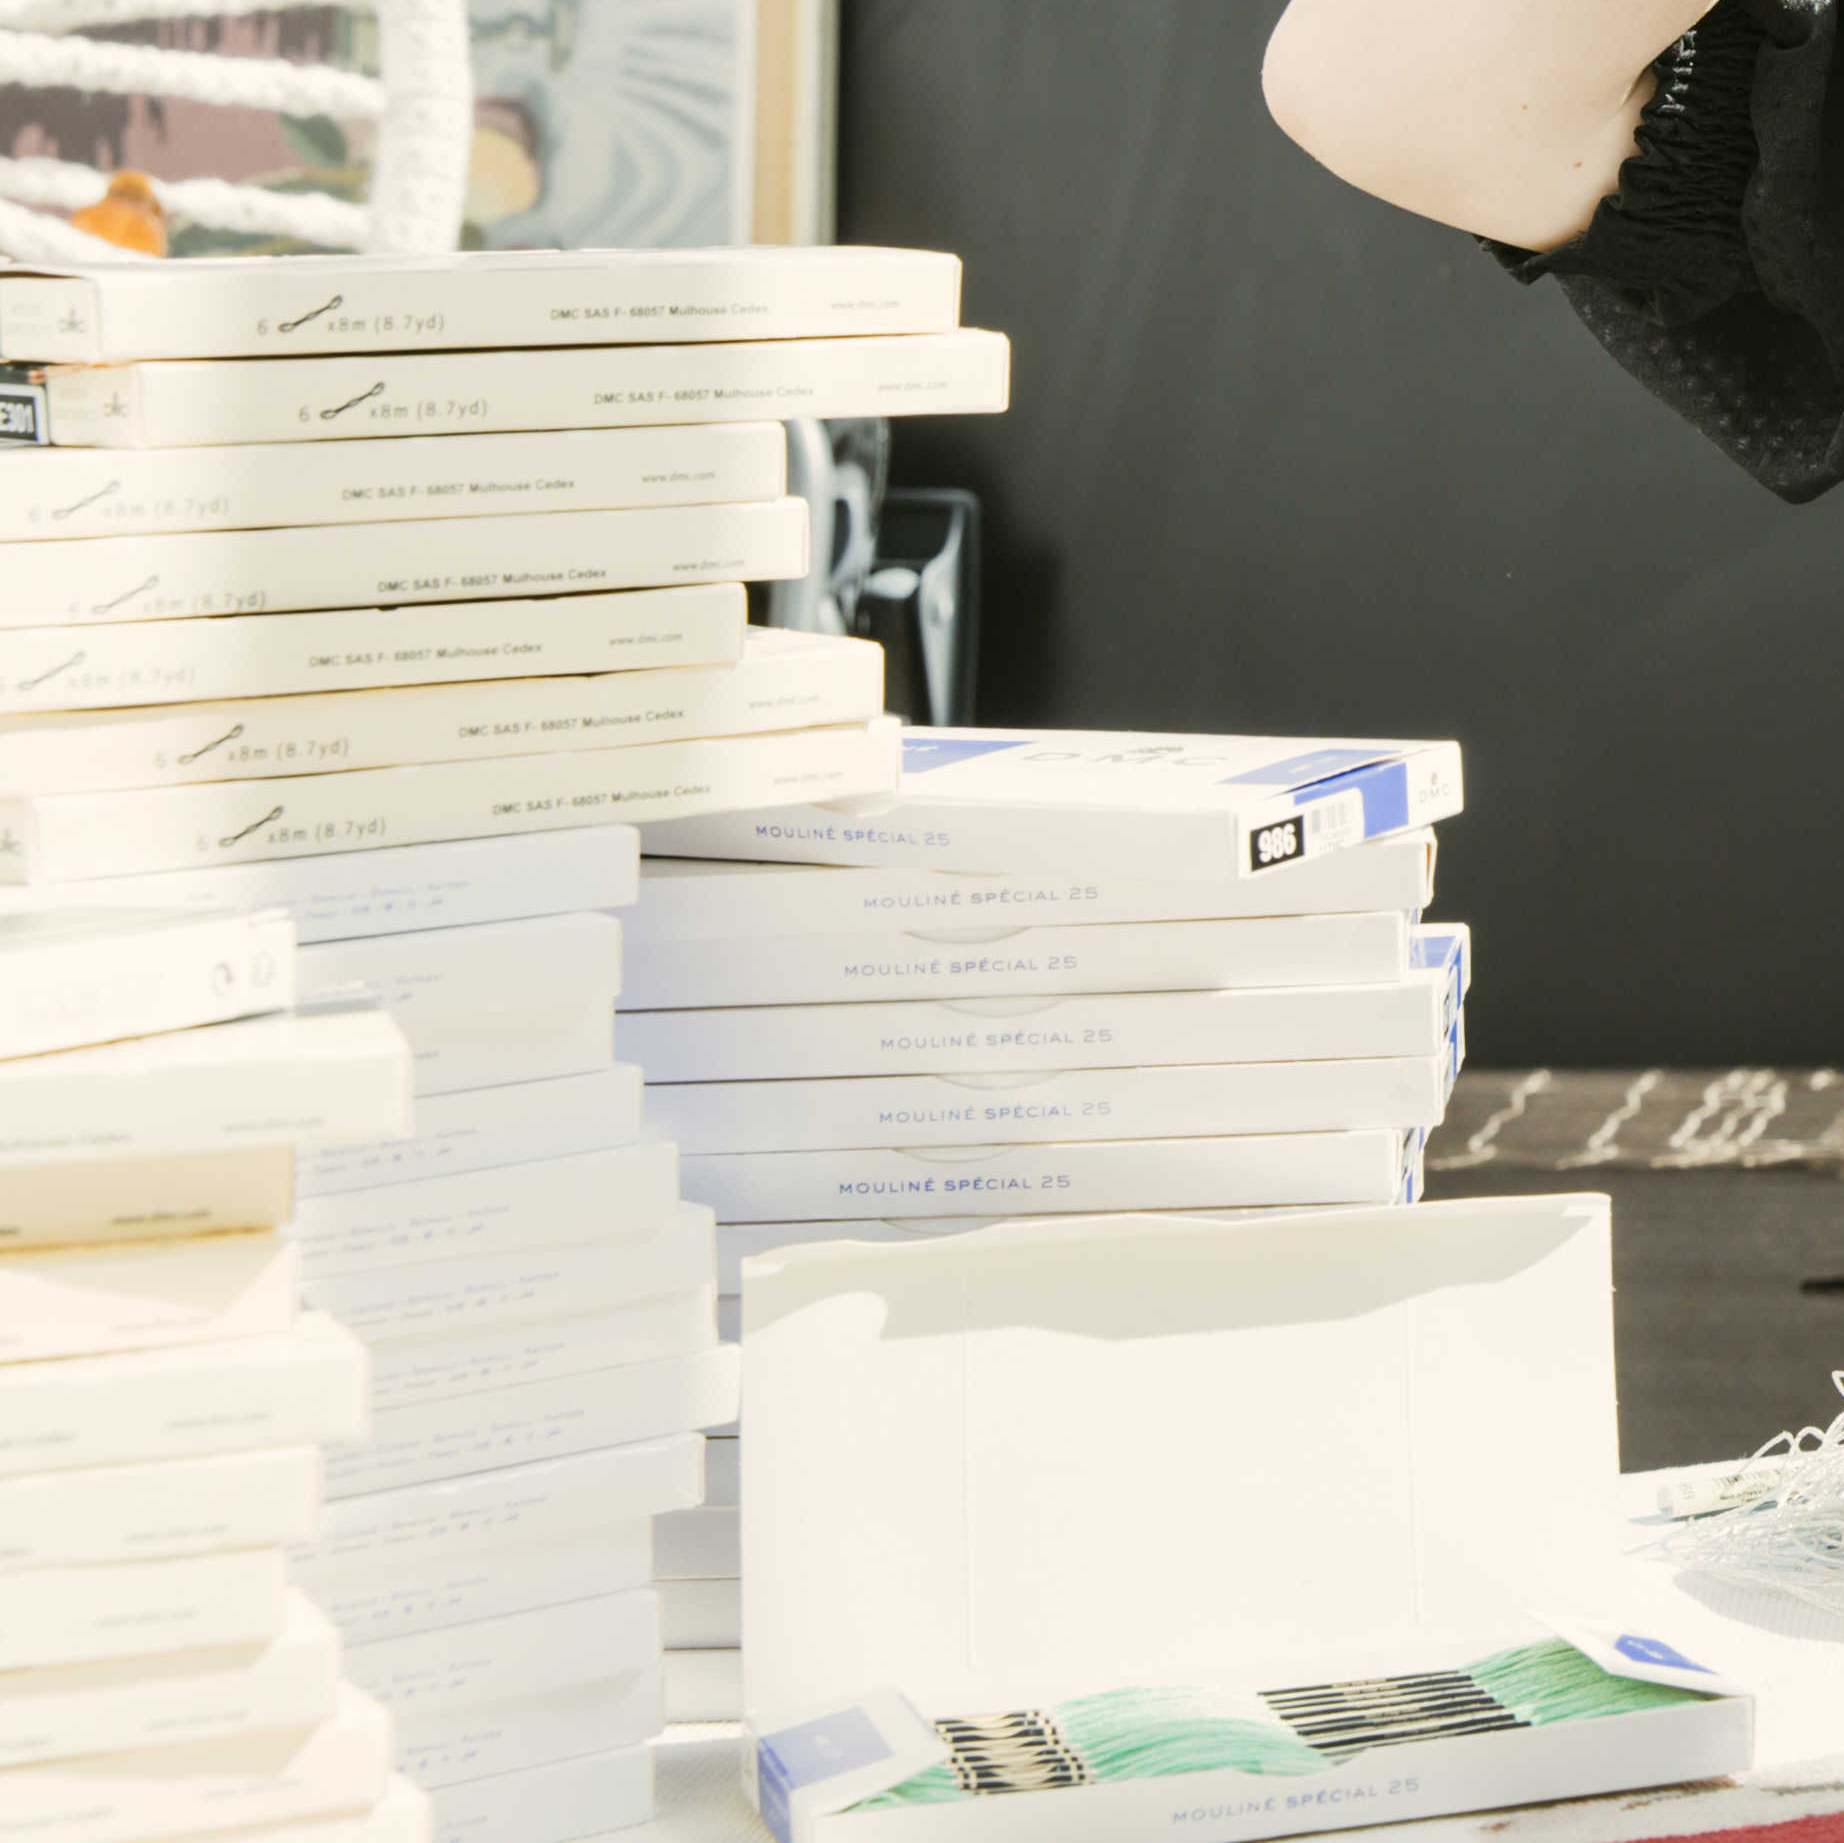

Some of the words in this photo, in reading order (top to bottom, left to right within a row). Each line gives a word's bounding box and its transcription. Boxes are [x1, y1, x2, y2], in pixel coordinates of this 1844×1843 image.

[550, 308, 580, 321] DMC
[584, 307, 611, 320] SAS
[669, 303, 727, 317] Mulhouse
[731, 302, 769, 315] Cedex
[327, 316, 366, 333] x8m
[374, 314, 446, 336] (8.7yd)
[594, 393, 624, 406] DMC
[628, 392, 654, 405] SAS
[713, 388, 772, 402] Mulhouse
[776, 386, 816, 399] Cedex
[369, 402, 408, 419] x8m
[416, 399, 489, 422] (8.7yd)
[342, 488, 372, 502] DMC
[377, 487, 405, 500] SAS
[469, 481, 531, 496] Mulhouse
[535, 479, 575, 492] Cedex
[378, 581, 407, 594] DMC
[413, 579, 440, 592] SAS
[502, 571, 563, 585] Mulhouse
[567, 568, 606, 581] Cedex
[309, 656, 340, 669] DMC
[345, 654, 373, 667] SAS
[436, 645, 499, 660] Mulhouse
[503, 642, 543, 656] Cedex
[458, 726, 490, 740] DMC
[494, 723, 521, 736] SAS
[582, 714, 641, 728] Mulhouse
[645, 708, 686, 722] Cedex
[492, 803, 522, 817] DMC
[526, 801, 554, 814] SAS
[611, 788, 670, 805] Mulhouse
[674, 784, 712, 797] Cedex
[754, 825, 837, 842] MOULINÉ
[841, 827, 918, 845] SPÉCIAL
[923, 830, 951, 847] 25
[1258, 823, 1298, 864] 986
[863, 890, 961, 909] MOULINÉ
[969, 887, 1060, 905] SPÉCIAL
[1068, 885, 1100, 901] 25
[844, 958, 942, 977] MOULINÉ
[950, 956, 1039, 974] SPÉCIAL
[1048, 955, 1079, 971] 25
[880, 1032, 977, 1050] MOULINÉ
[986, 1029, 1074, 1047] SPÉCIAL
[1082, 1028, 1113, 1044] 25
[879, 1105, 977, 1123] MOULINÉ
[983, 1101, 1072, 1120] SPÉCIAL
[1080, 1101, 1111, 1116] 25
[839, 1177, 936, 1195] MOULINÉ
[943, 1175, 1032, 1193] SPÉCIAL
[1040, 1173, 1072, 1190] 25
[1388, 1776, 1421, 1797] 25
